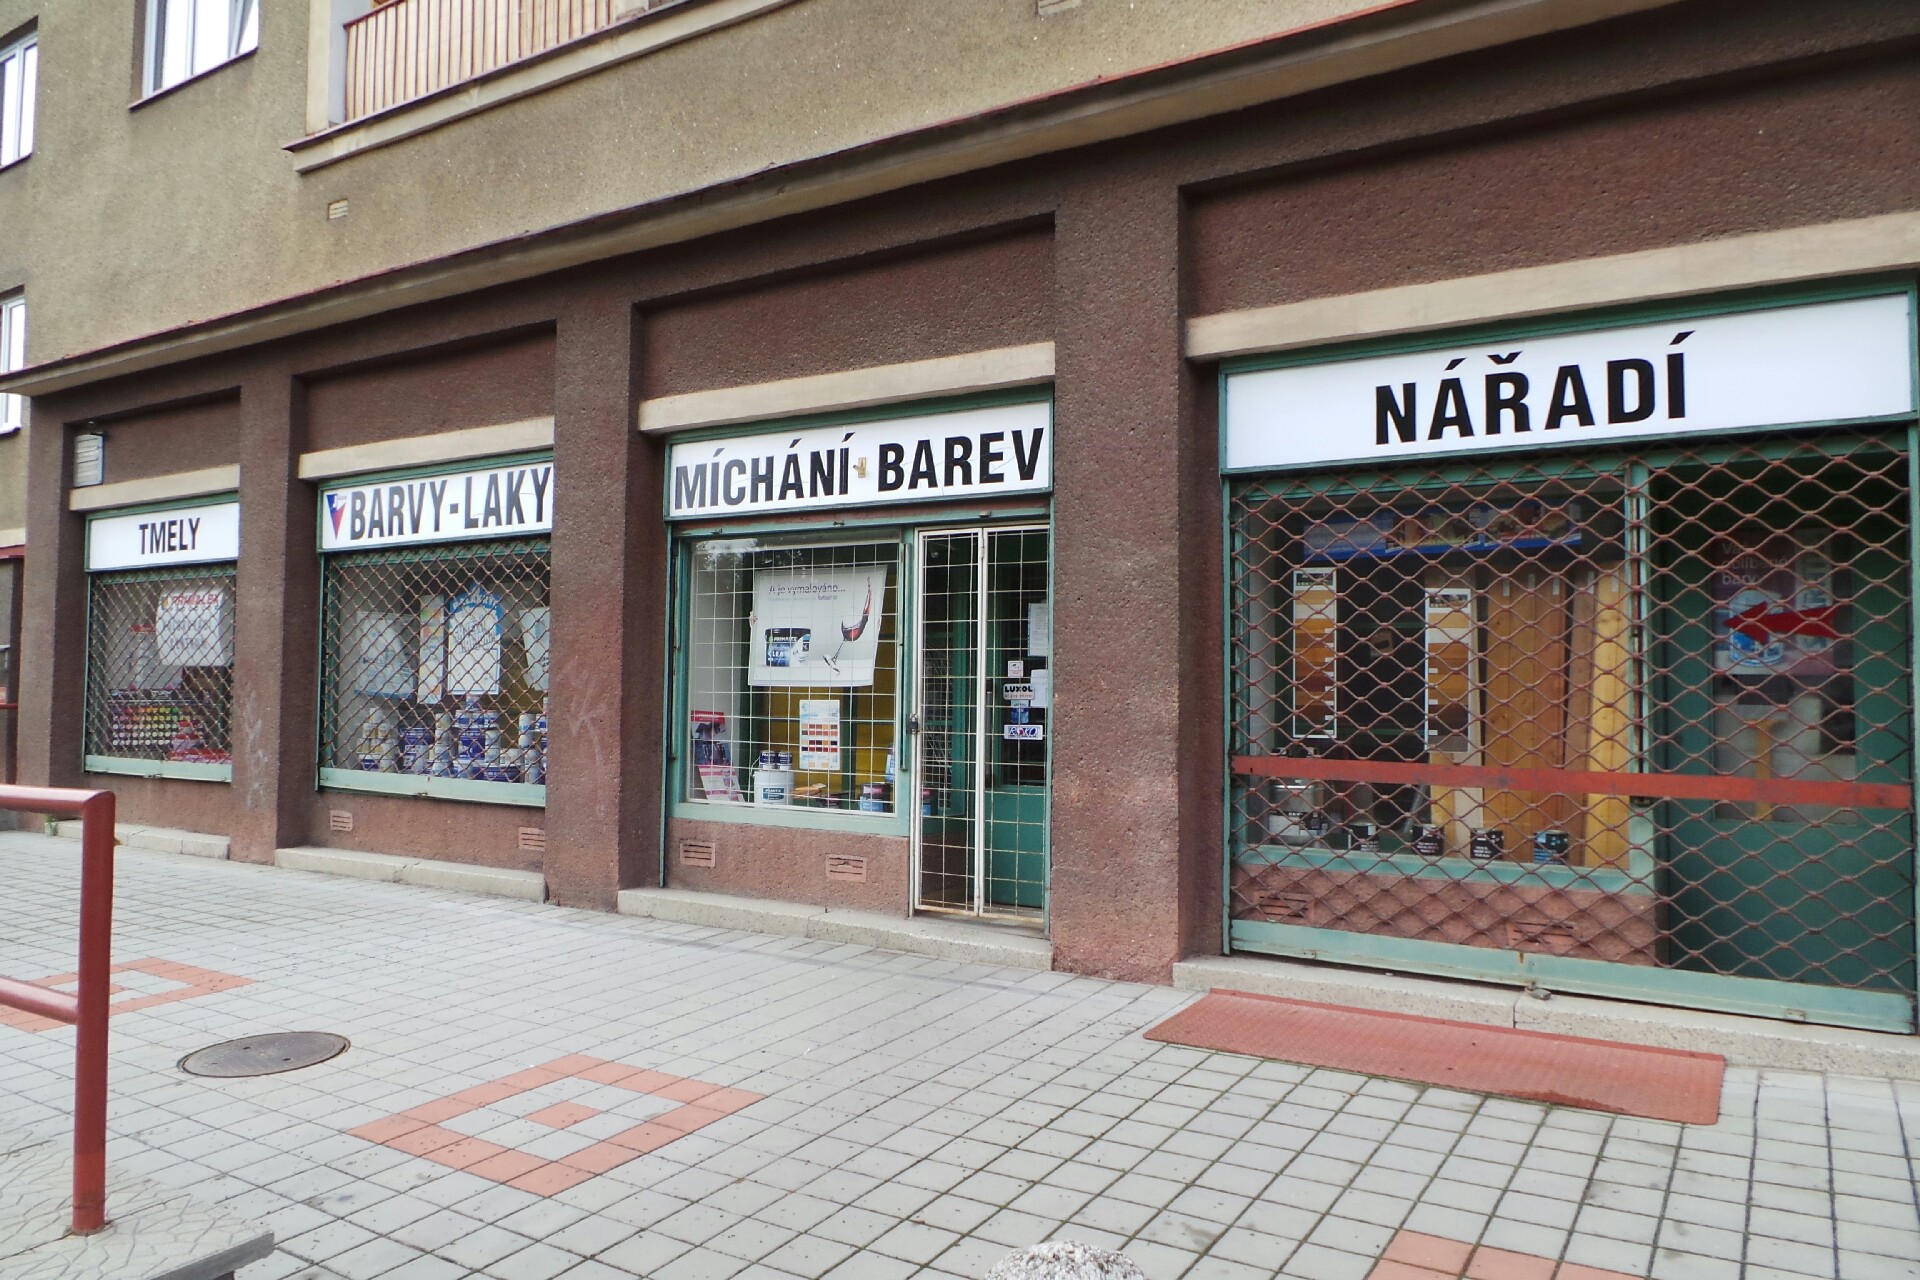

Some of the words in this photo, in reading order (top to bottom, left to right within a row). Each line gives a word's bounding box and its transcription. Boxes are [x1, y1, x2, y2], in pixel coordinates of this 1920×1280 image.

[1373, 329, 1696, 446] NÁŘADÍ
[350, 466, 552, 541] BARVY-LAKY
[674, 432, 856, 510] MÍCHÁNÍ
[877, 427, 1045, 493] BAREV
[138, 517, 201, 555] TMELY
[1004, 685, 1034, 693] LUXOL
